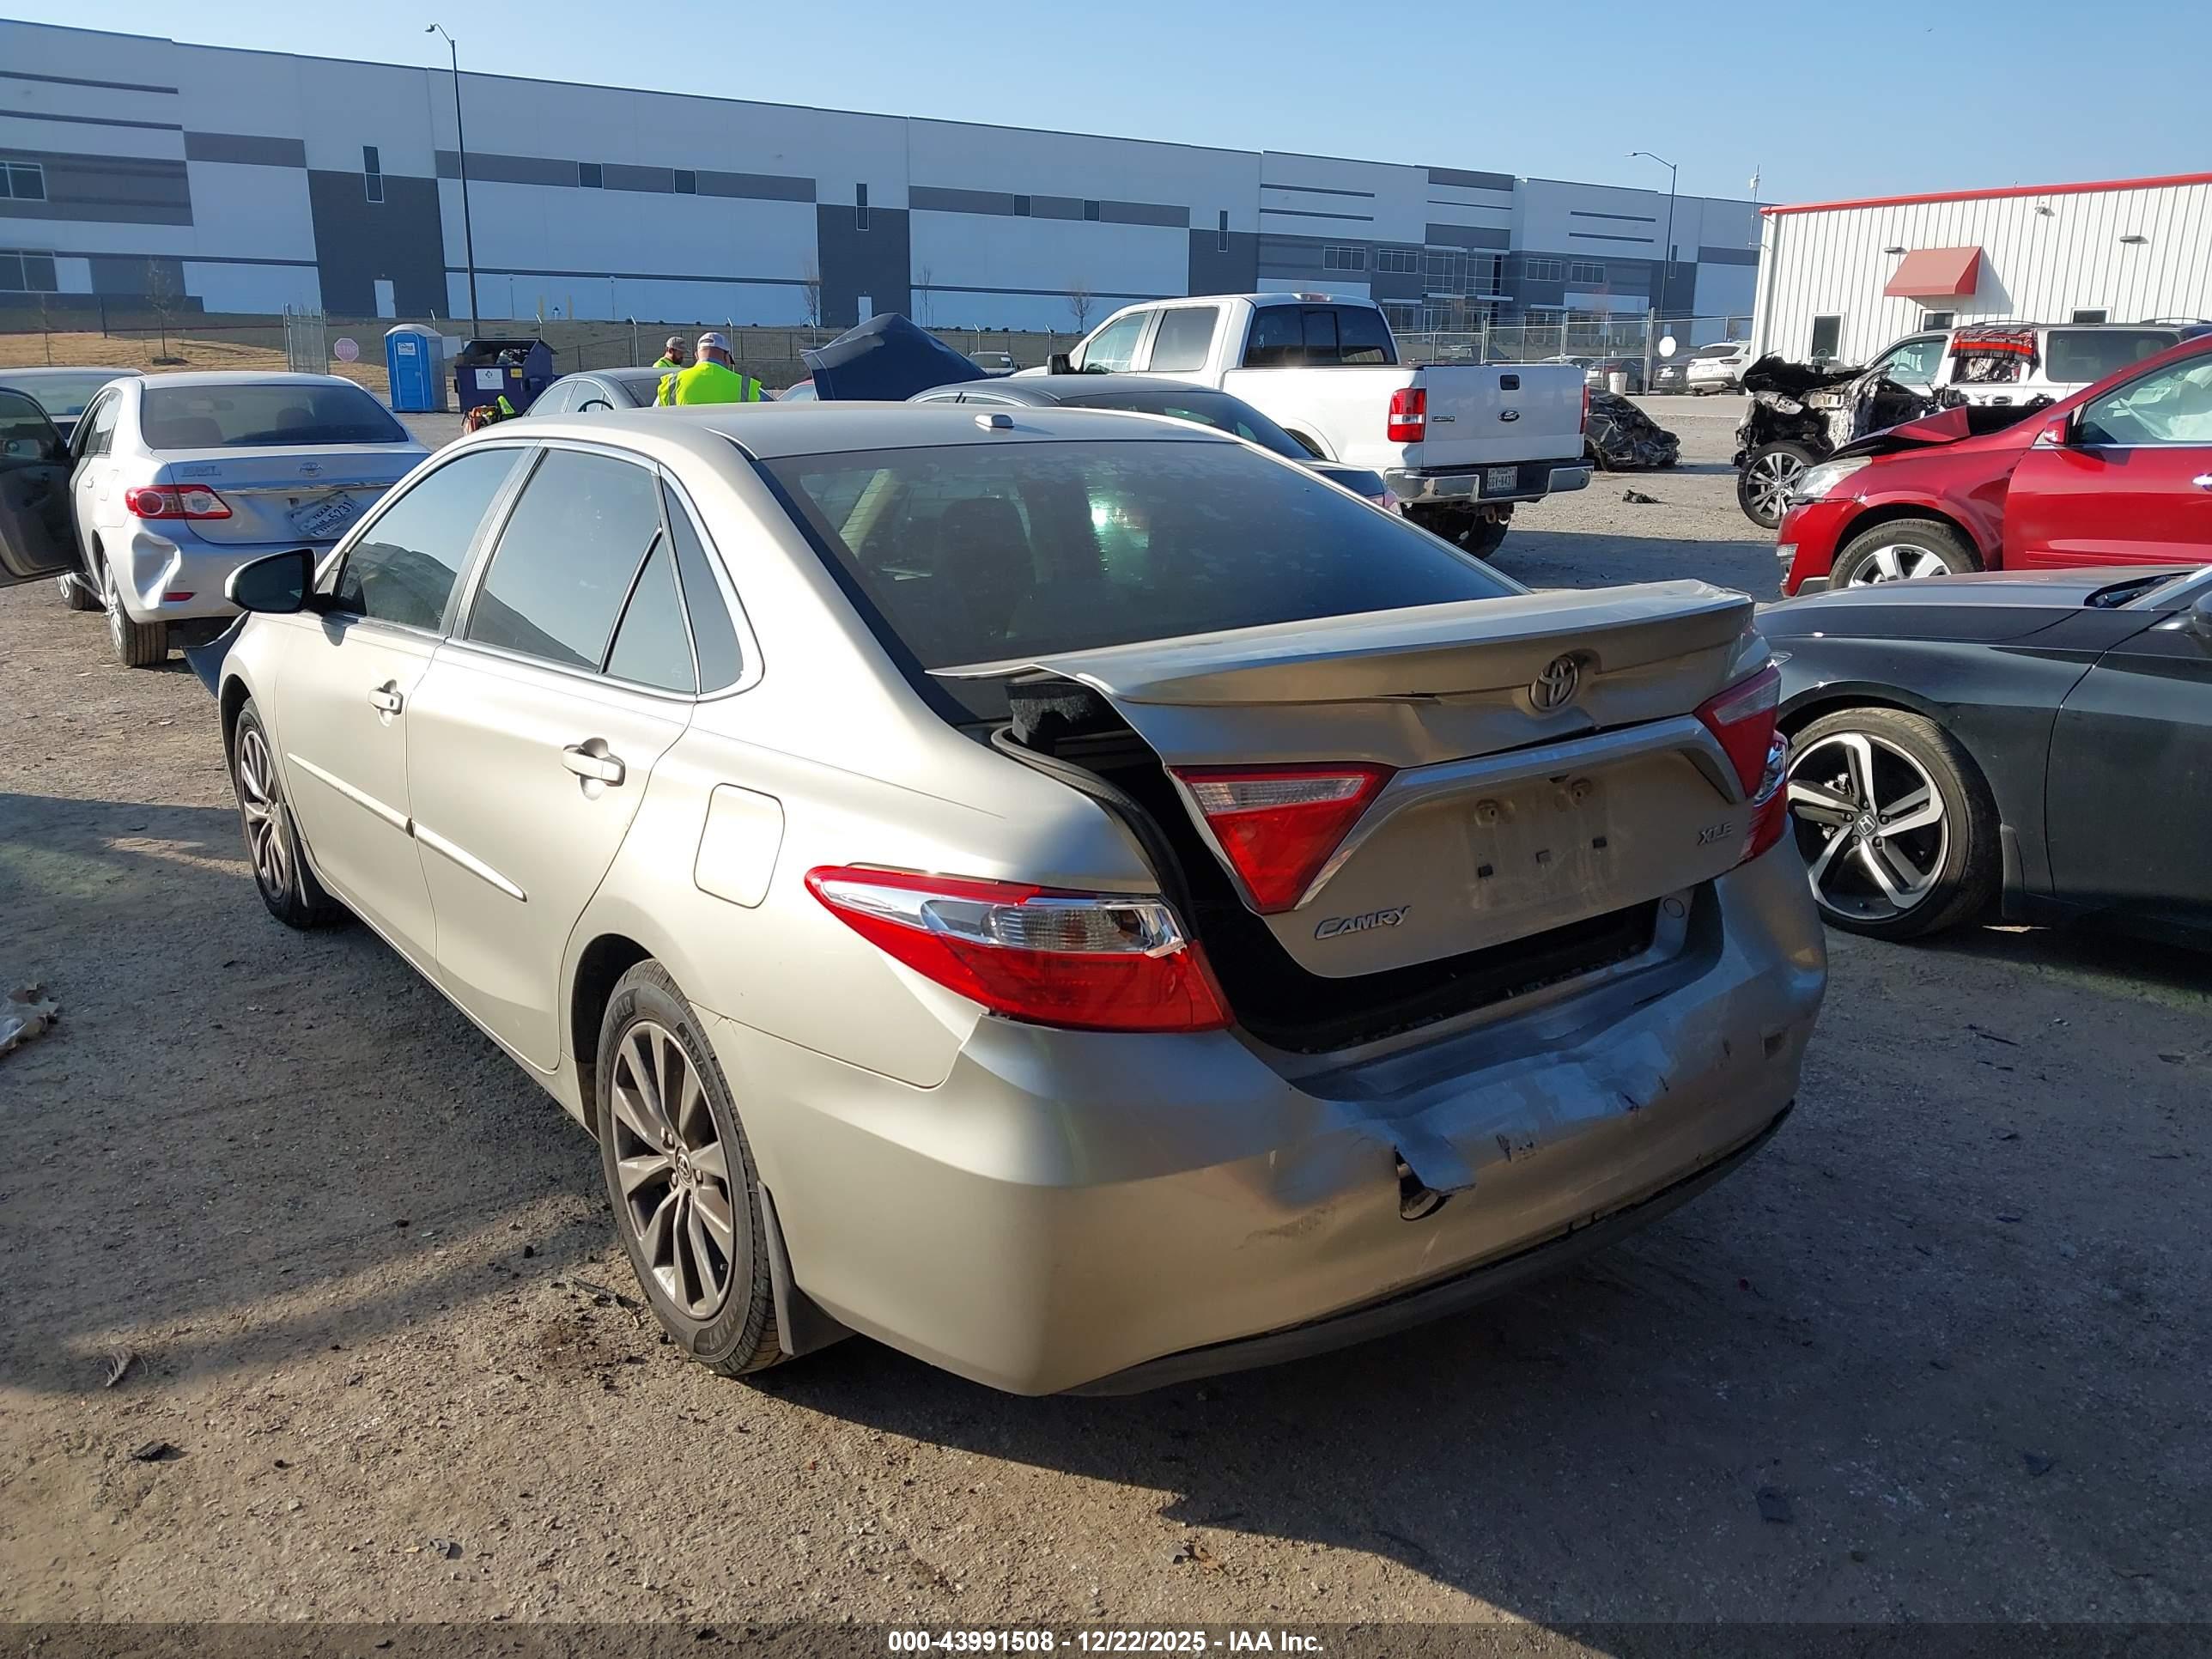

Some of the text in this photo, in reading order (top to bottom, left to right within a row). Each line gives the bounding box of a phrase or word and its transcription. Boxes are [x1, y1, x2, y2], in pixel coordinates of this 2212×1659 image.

[337, 344, 358, 355] STOP
[1697, 822, 1733, 846] XLE
[1314, 905, 1412, 940] CAMRY
